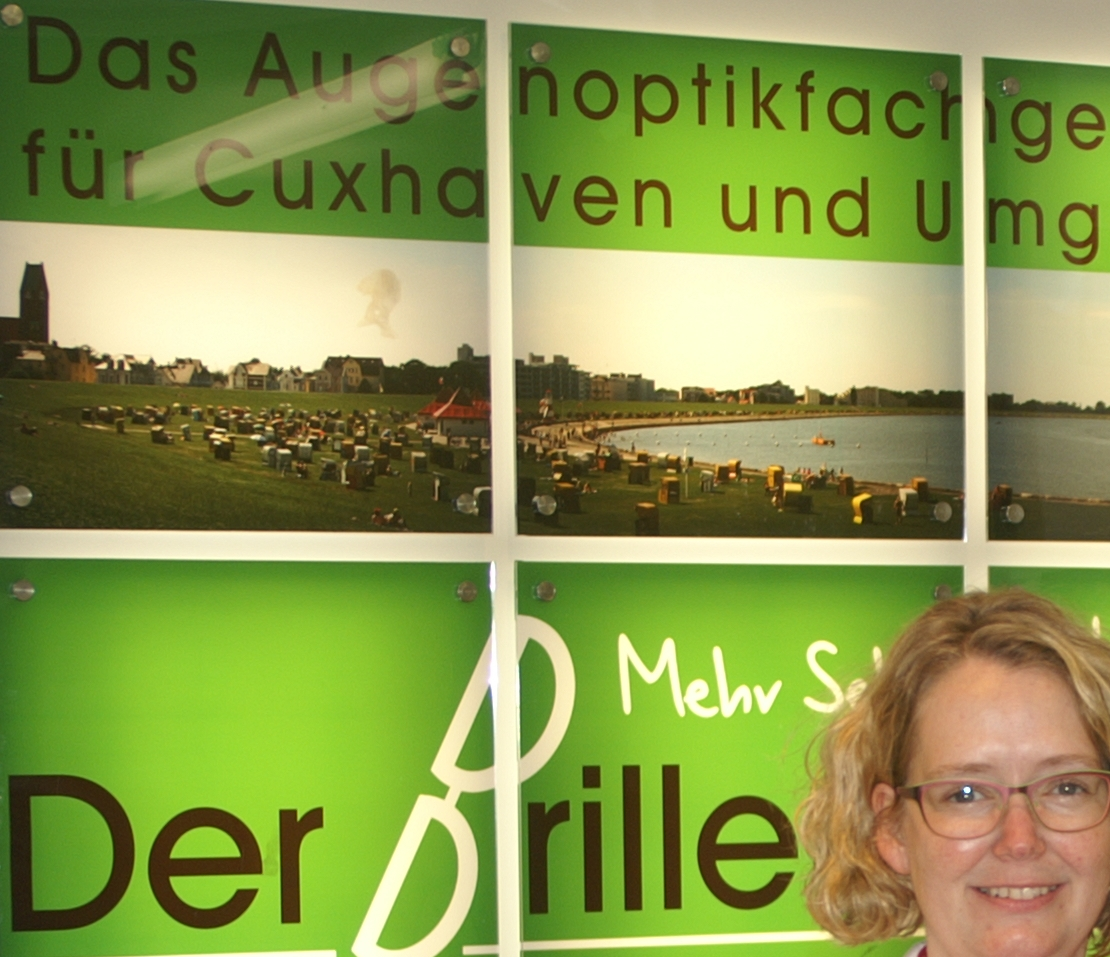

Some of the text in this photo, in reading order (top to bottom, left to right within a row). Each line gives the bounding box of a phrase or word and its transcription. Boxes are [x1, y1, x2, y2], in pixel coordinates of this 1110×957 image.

[27, 17, 198, 94] Das
[21, 129, 144, 200] für
[195, 138, 673, 228] Cuxhaven
[720, 176, 871, 238] und
[617, 632, 783, 719] Mehr
[8, 774, 324, 932] Der
